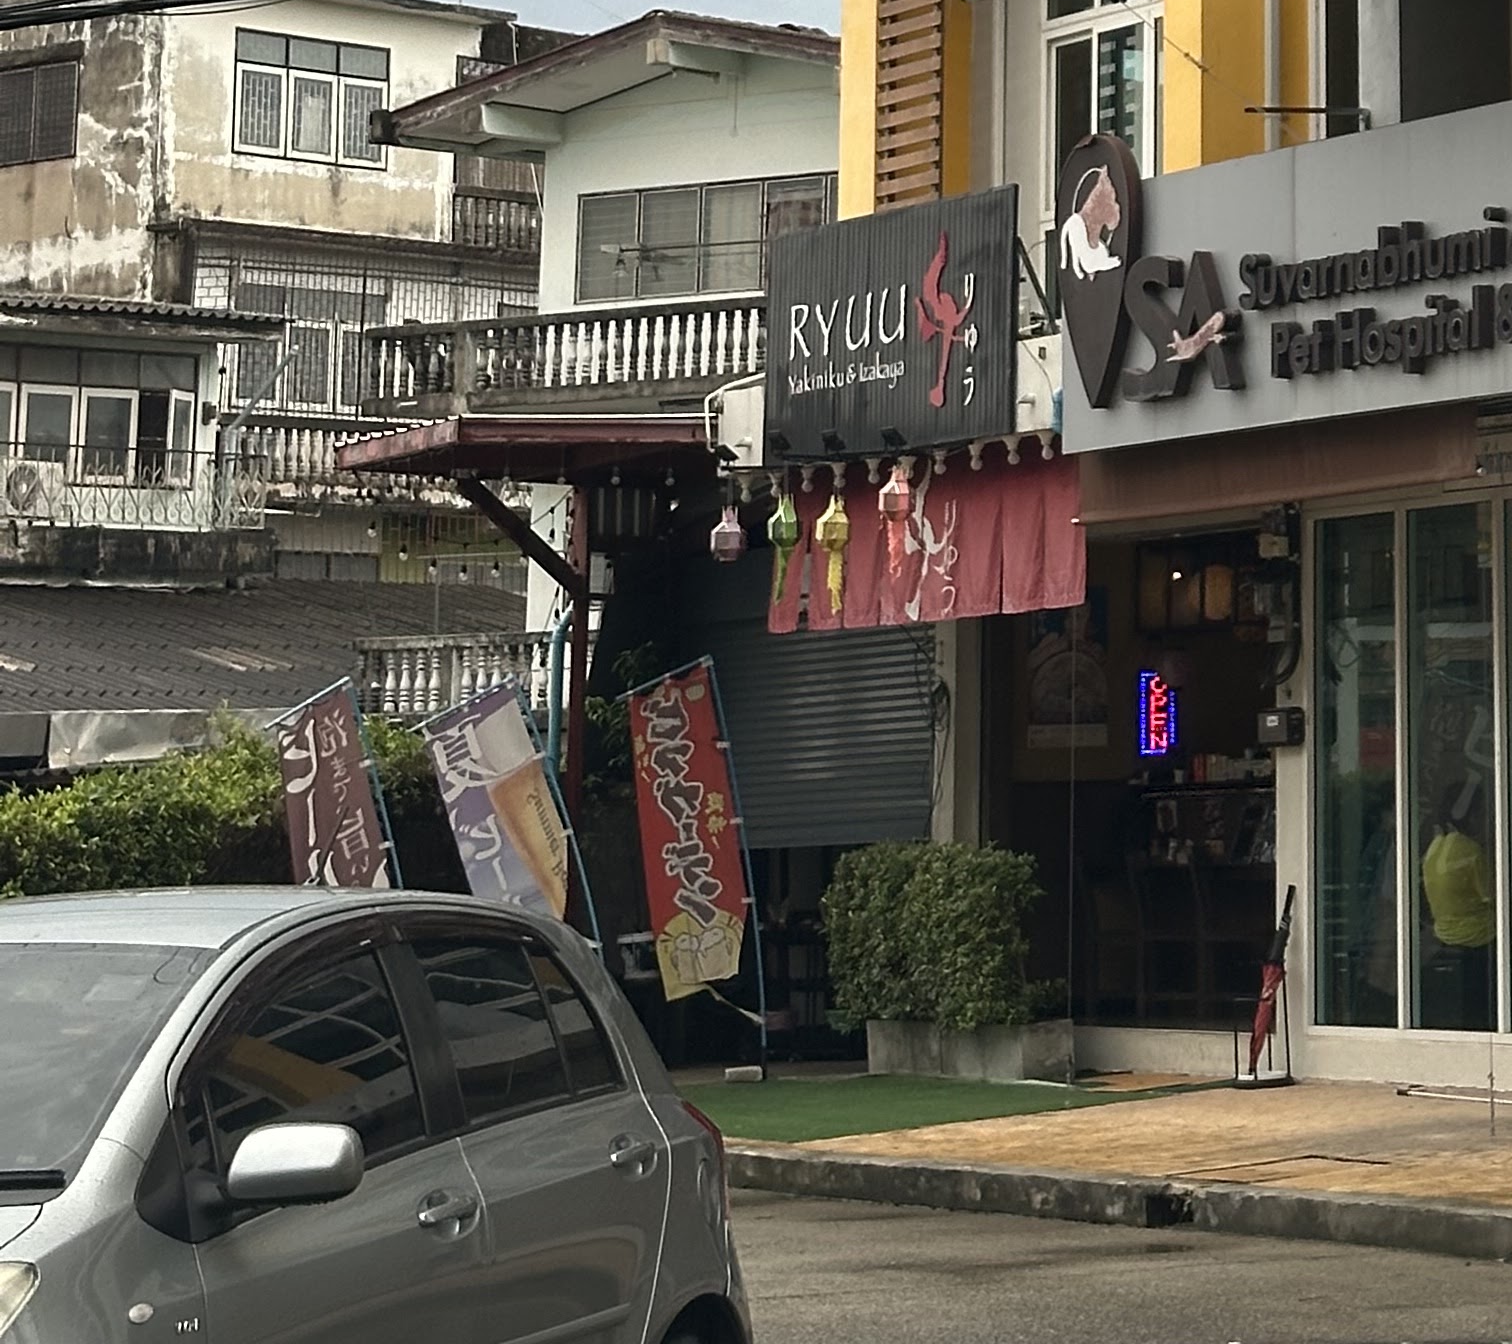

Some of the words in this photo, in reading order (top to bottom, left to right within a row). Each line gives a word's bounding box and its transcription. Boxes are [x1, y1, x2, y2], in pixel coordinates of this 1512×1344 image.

[1238, 206, 1508, 311] Suvarnabhumi
[789, 283, 907, 361] RYUU
[1270, 318, 1336, 380] Pet
[1335, 284, 1496, 375] Hospital
[788, 360, 844, 396] Yakiniku
[846, 363, 857, 385] &
[859, 351, 905, 390] Izakaya
[1149, 676, 1168, 750] OPEN
